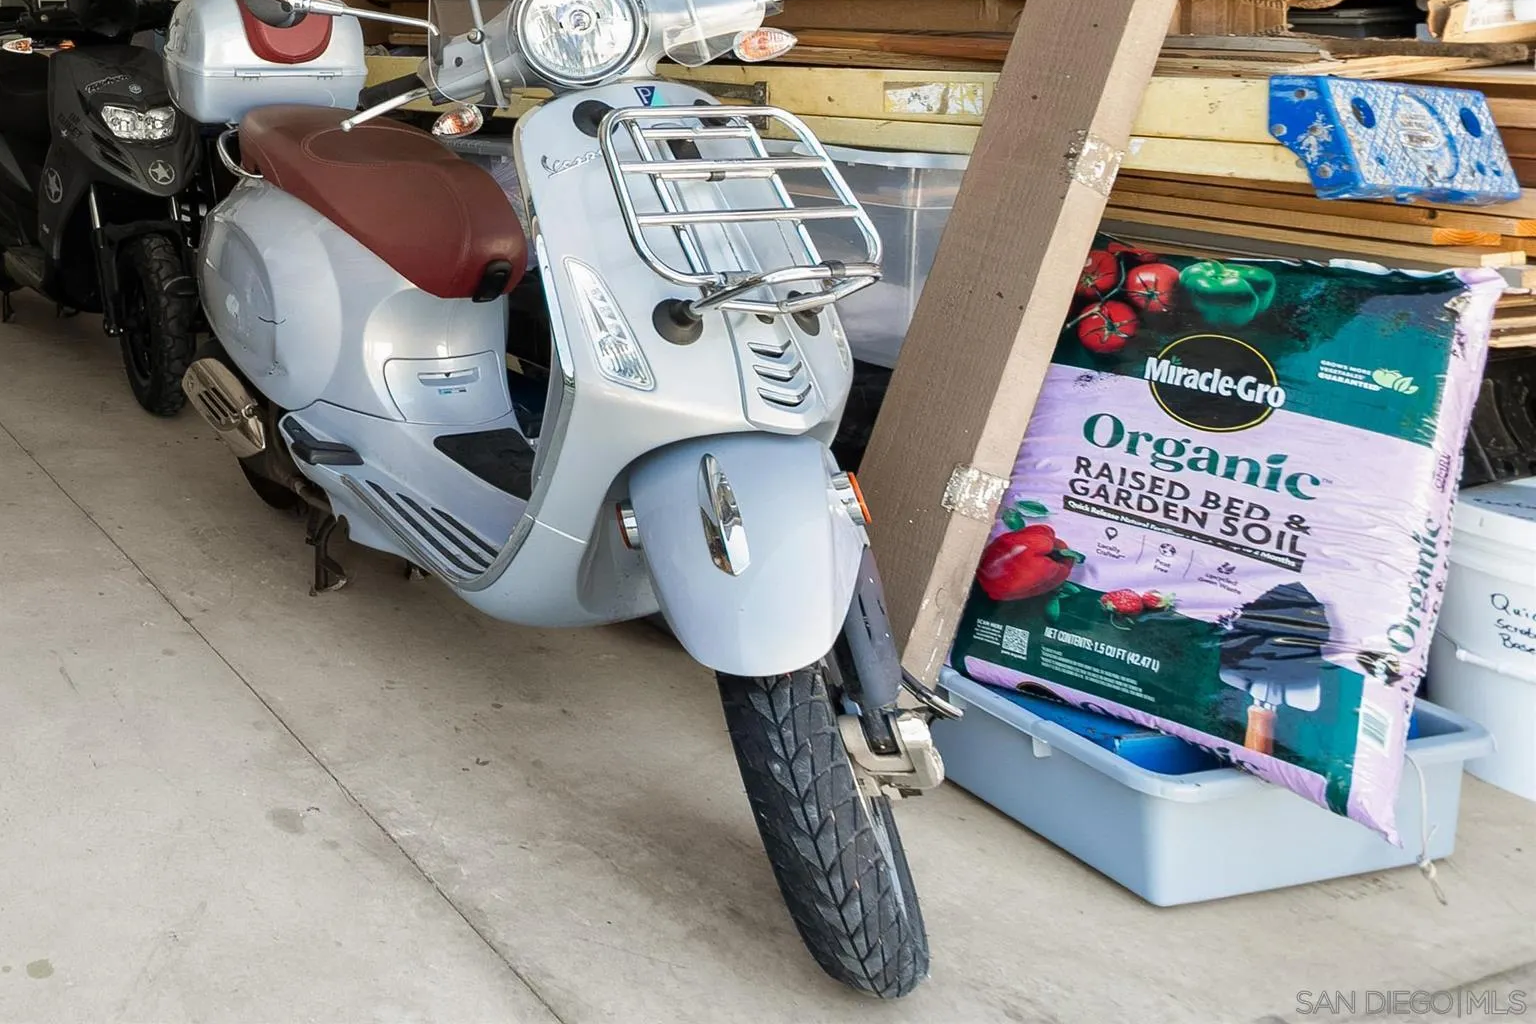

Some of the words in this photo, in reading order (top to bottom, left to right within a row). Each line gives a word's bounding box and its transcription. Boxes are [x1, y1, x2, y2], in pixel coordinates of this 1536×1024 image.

[1144, 356, 1286, 408] Miracle-Gro
[1083, 413, 1322, 500] Organic
[1067, 499, 1090, 512] Quick
[1091, 505, 1120, 521] Release
[1068, 478, 1209, 529] GARDEN
[1219, 516, 1308, 558] SOIL
[1073, 456, 1191, 502] RAISED
[1200, 491, 1272, 522] BED
[1284, 514, 1312, 536] &
[1261, 551, 1297, 568] Months
[1386, 517, 1442, 654] Organic
[1044, 626, 1058, 640] NET
[1057, 630, 1093, 651] CONTENTS:
[1093, 641, 1106, 653] 1.5
[1105, 644, 1116, 657] CU
[1116, 648, 1127, 661] FT
[1127, 650, 1152, 668] (42.47
[1151, 658, 1160, 673] L)
